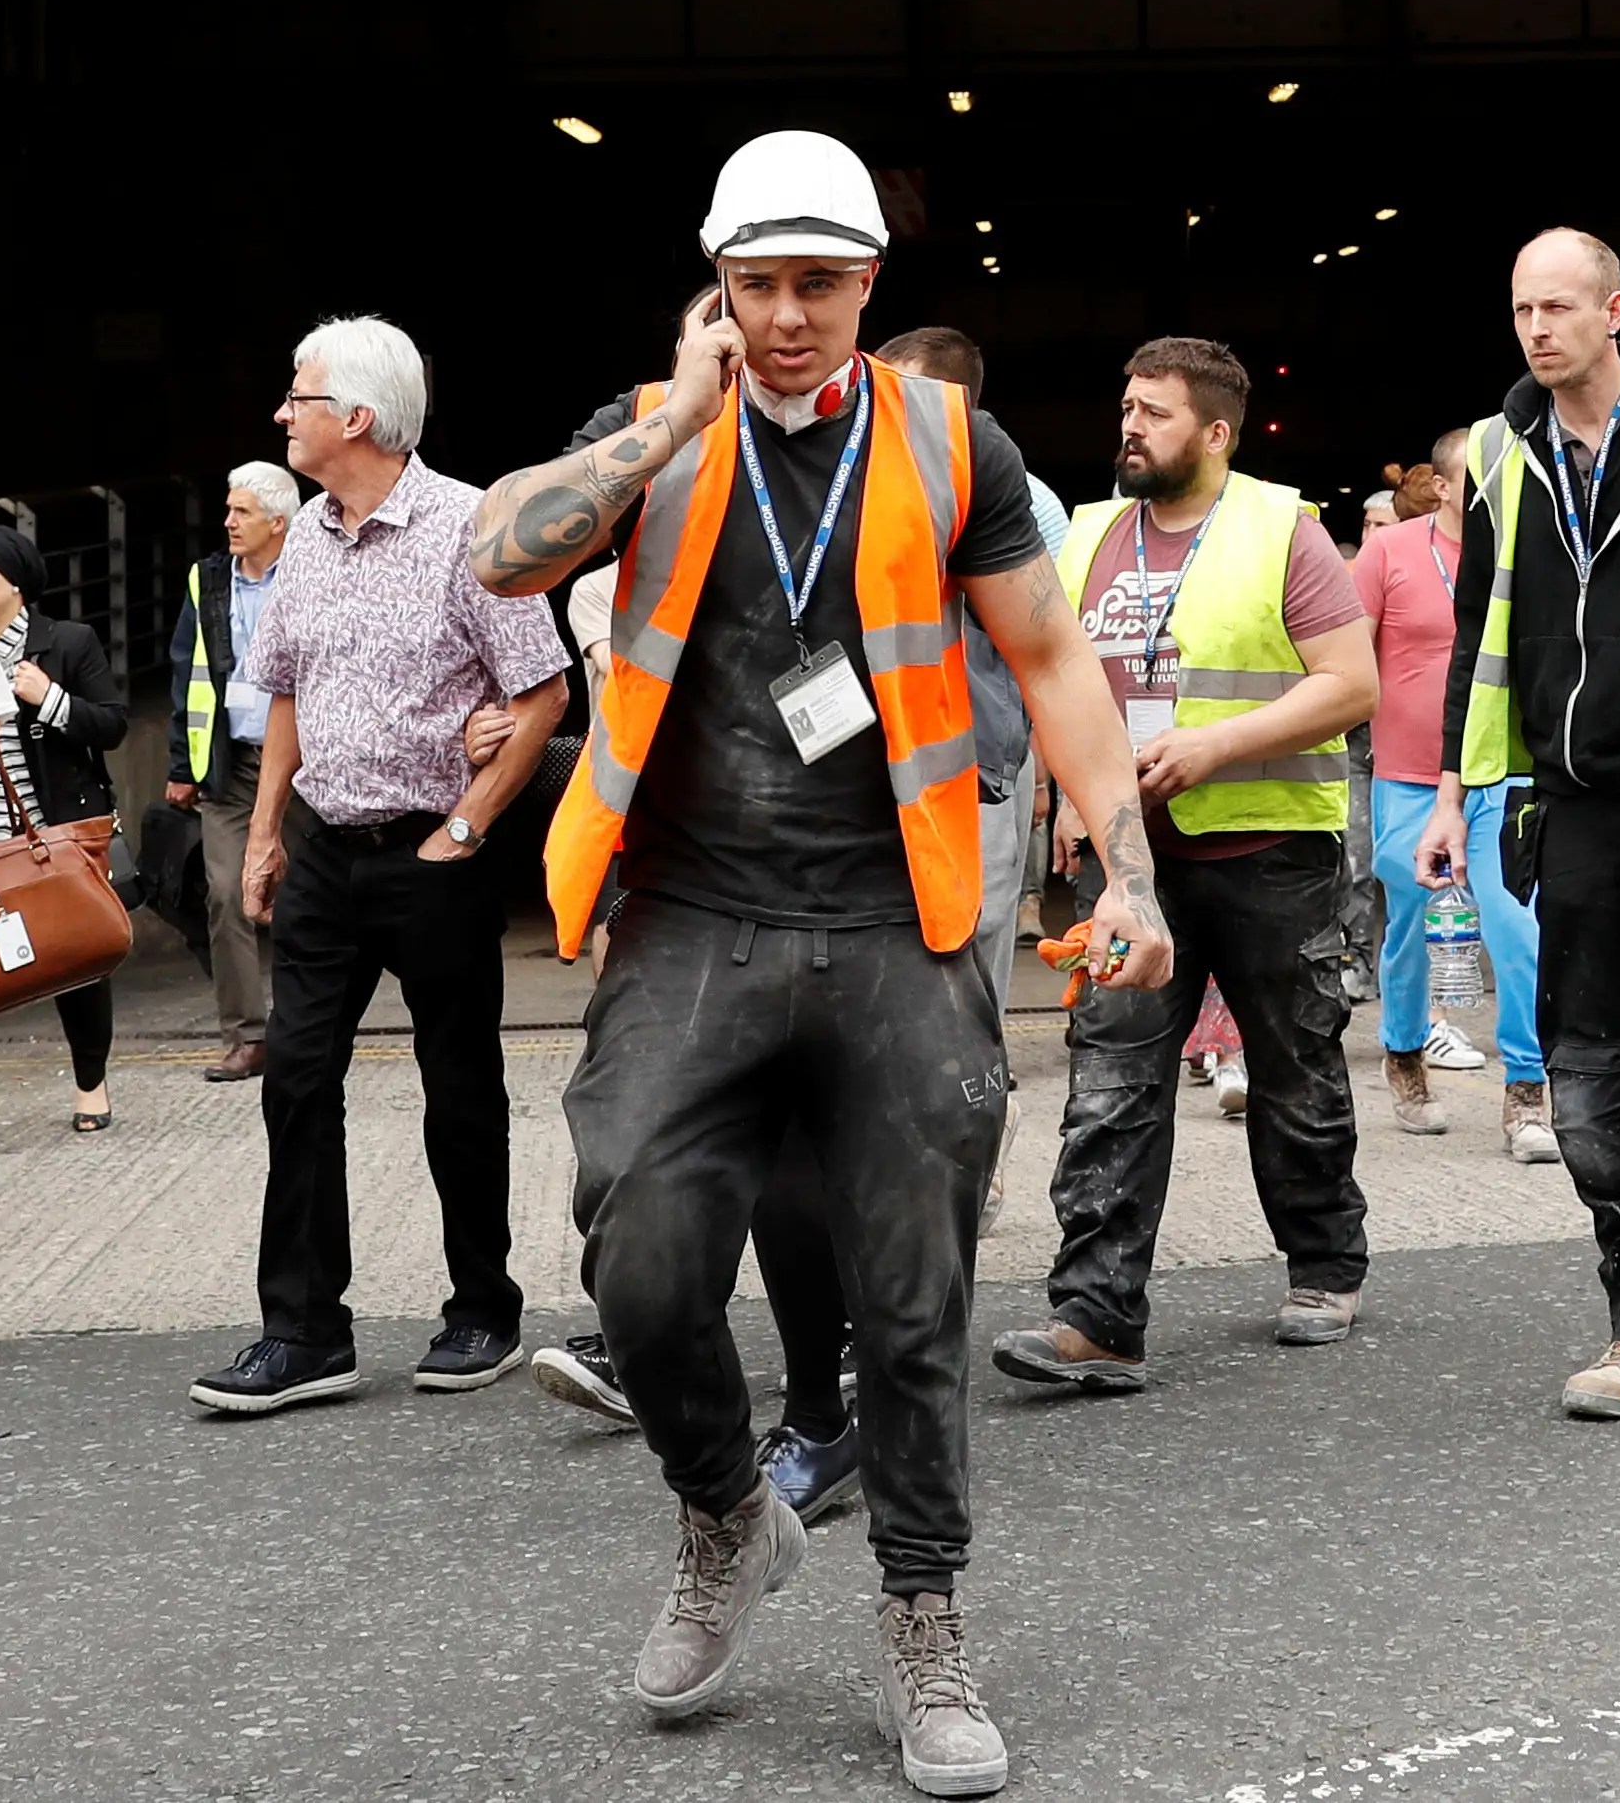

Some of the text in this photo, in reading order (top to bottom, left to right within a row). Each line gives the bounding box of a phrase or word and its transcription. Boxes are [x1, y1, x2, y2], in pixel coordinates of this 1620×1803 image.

[848, 391, 869, 451] CONTRACTOR
[740, 424, 764, 490] CONTRACTOR
[821, 462, 850, 529] CONTRACTOR
[760, 503, 789, 575] CONTRACTOR
